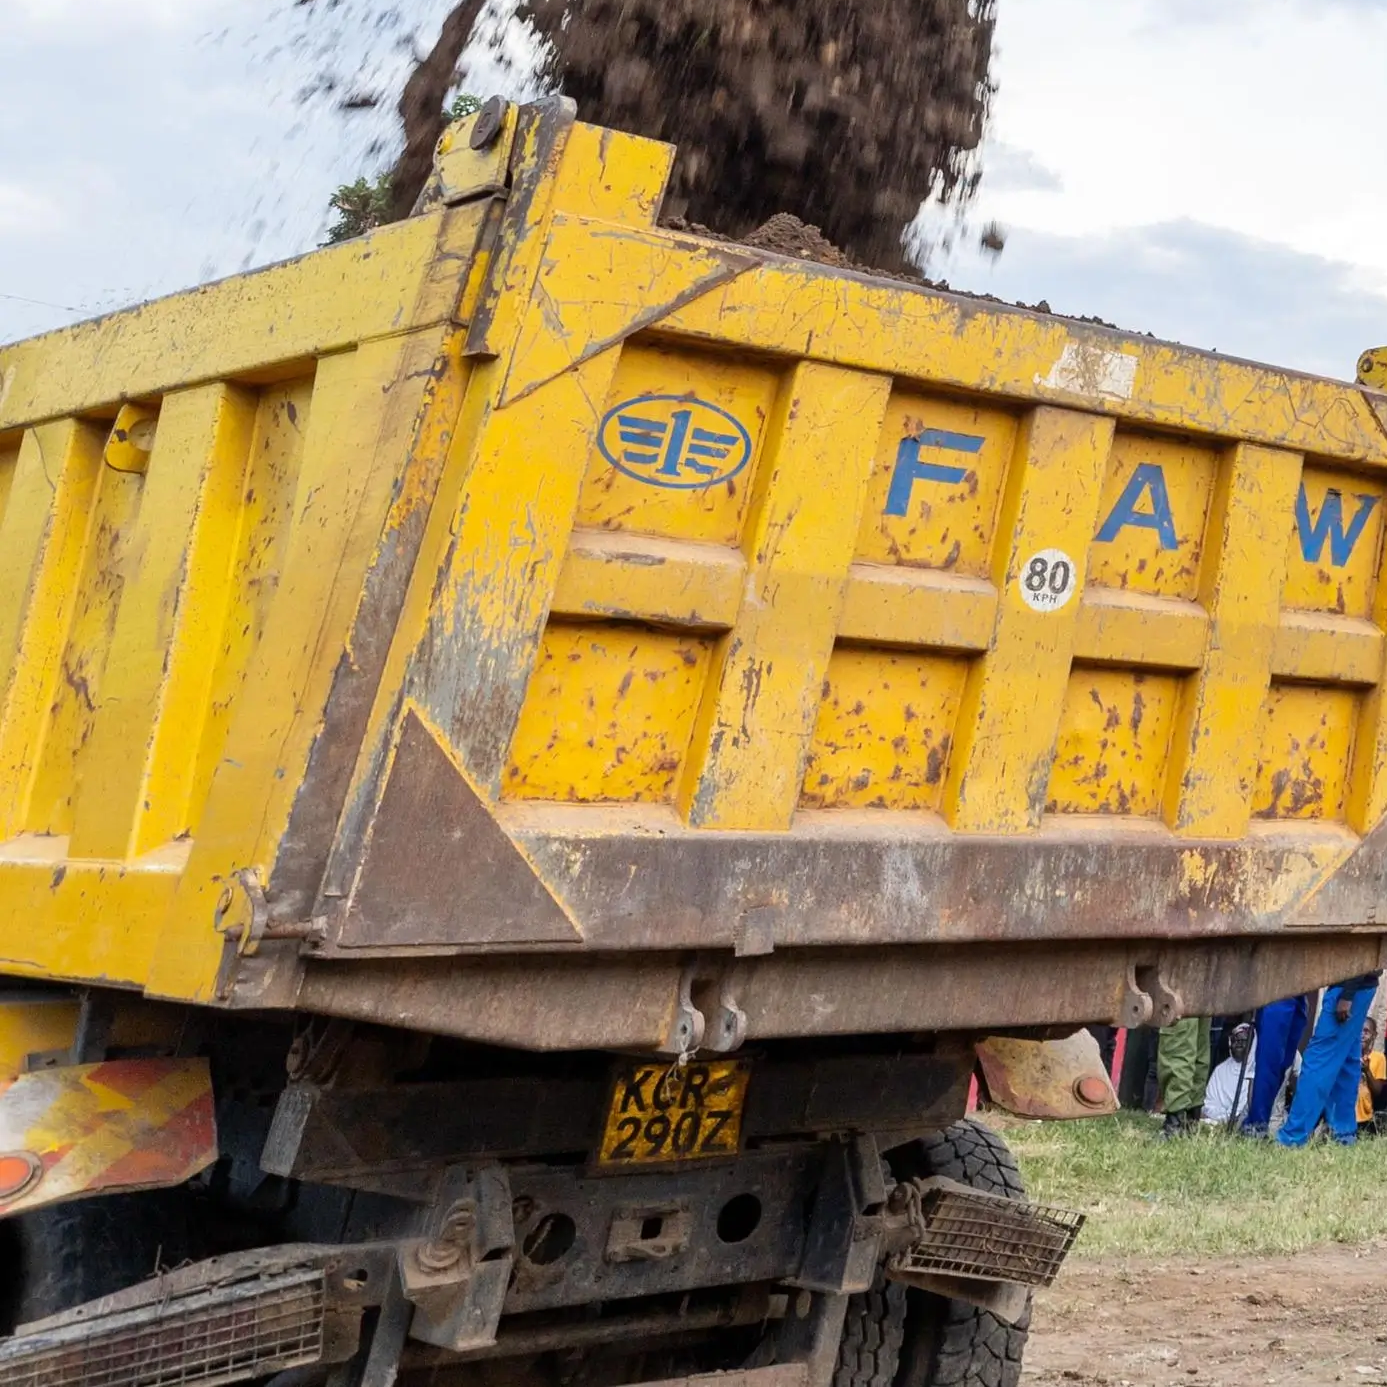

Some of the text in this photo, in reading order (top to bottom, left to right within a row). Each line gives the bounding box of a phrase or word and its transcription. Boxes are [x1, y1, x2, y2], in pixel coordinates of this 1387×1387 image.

[1025, 557, 1070, 595] 80
[1033, 593, 1057, 604] KPH
[617, 1066, 710, 1113] KCR
[610, 1110, 734, 1159] 290Z
